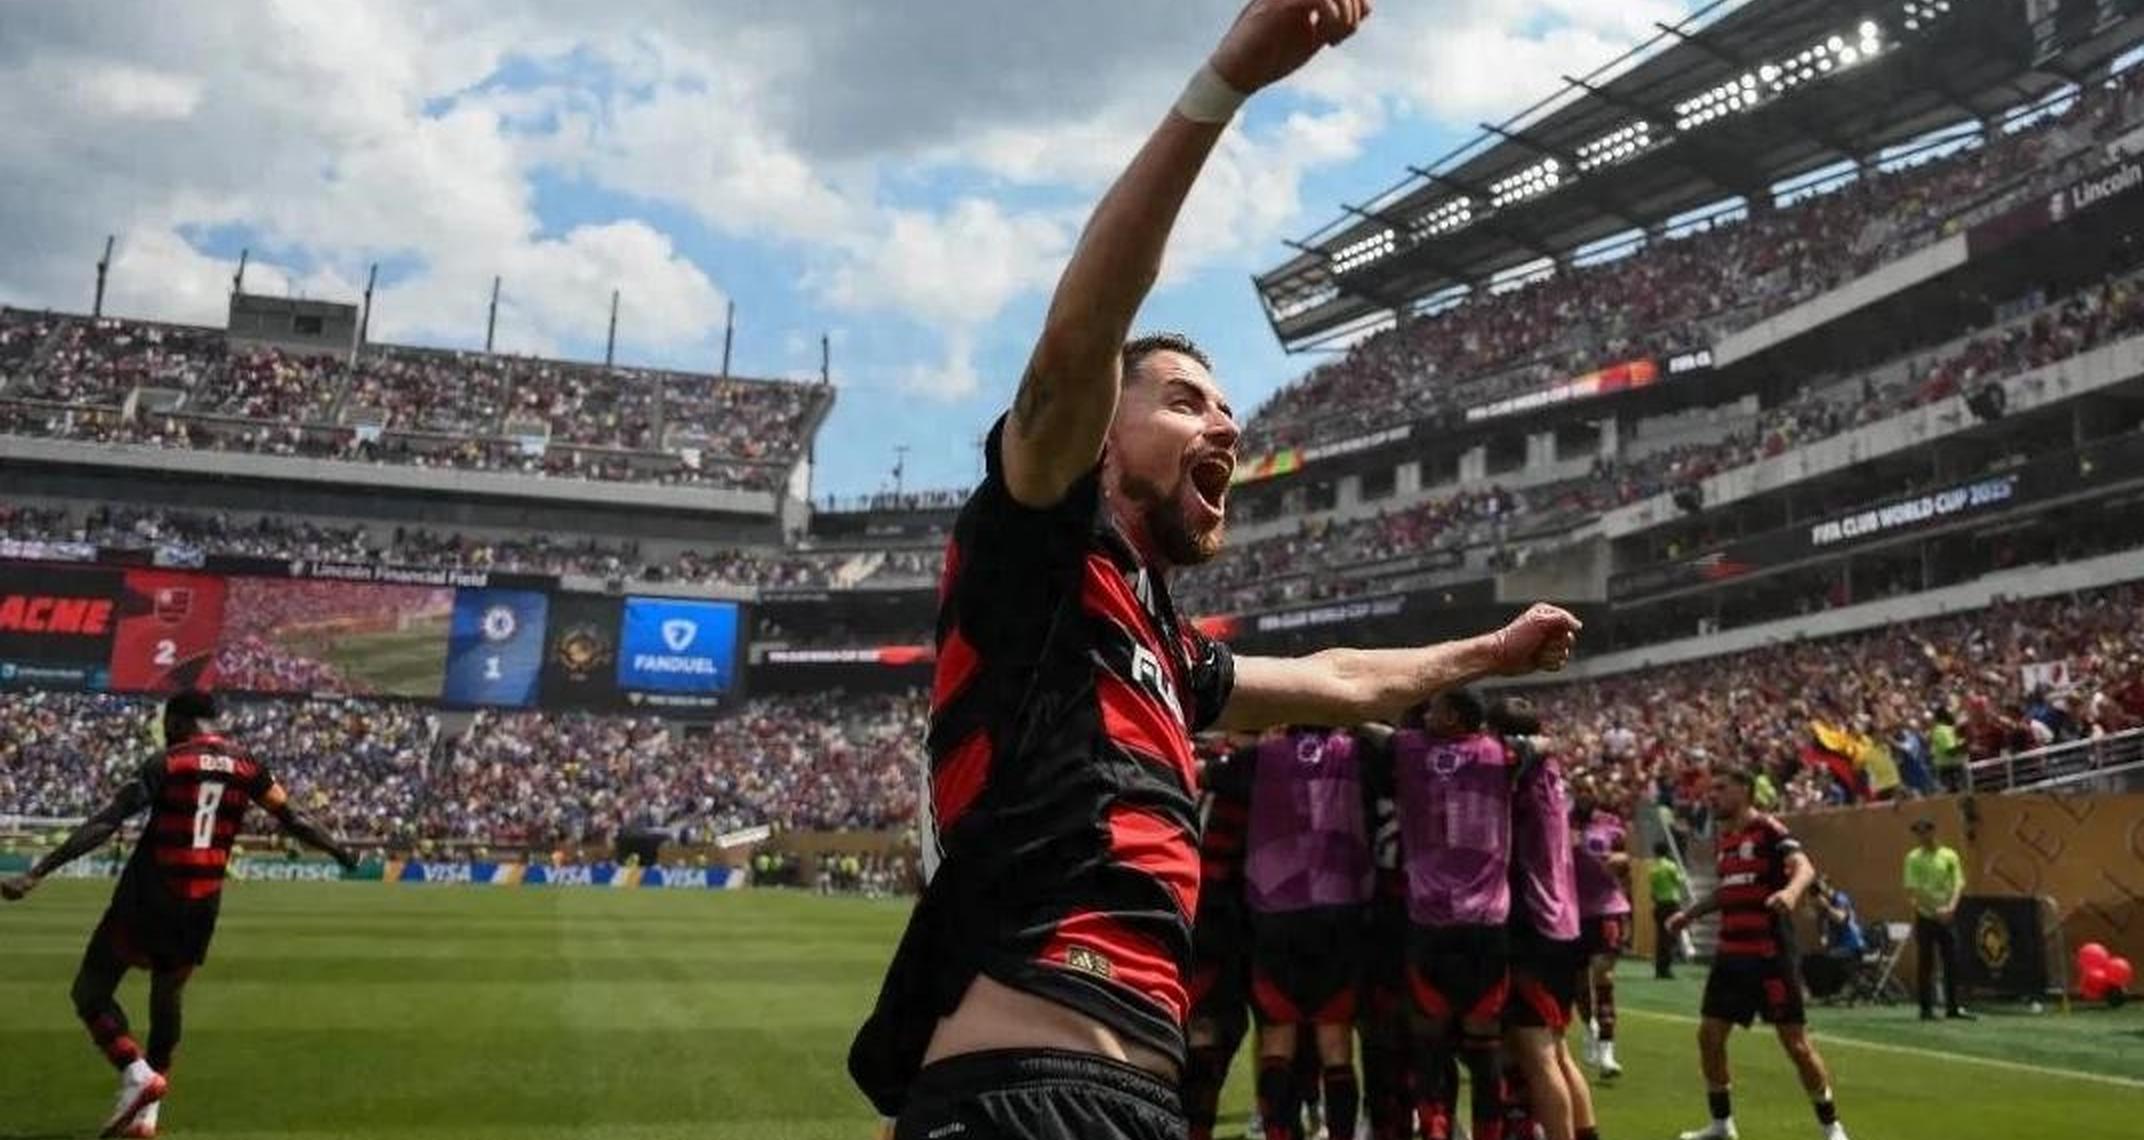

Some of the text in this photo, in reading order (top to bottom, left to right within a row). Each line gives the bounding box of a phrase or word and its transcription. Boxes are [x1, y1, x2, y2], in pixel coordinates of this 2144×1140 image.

[2072, 164, 2142, 208] Lincoln
[1812, 522, 1842, 544] FIFA
[1843, 512, 1879, 537] CLUB
[1879, 499, 1934, 527] WORLD
[1936, 488, 1968, 513] CUP
[312, 562, 488, 586] Lincoln Financial Field
[0, 596, 113, 634] ACME
[154, 640, 176, 664] 2
[485, 656, 501, 679] 1
[634, 655, 717, 674] FANDUEL
[193, 782, 226, 849] 8
[423, 863, 471, 882] VISA
[545, 865, 593, 884] VISA
[661, 868, 708, 887] VISA
